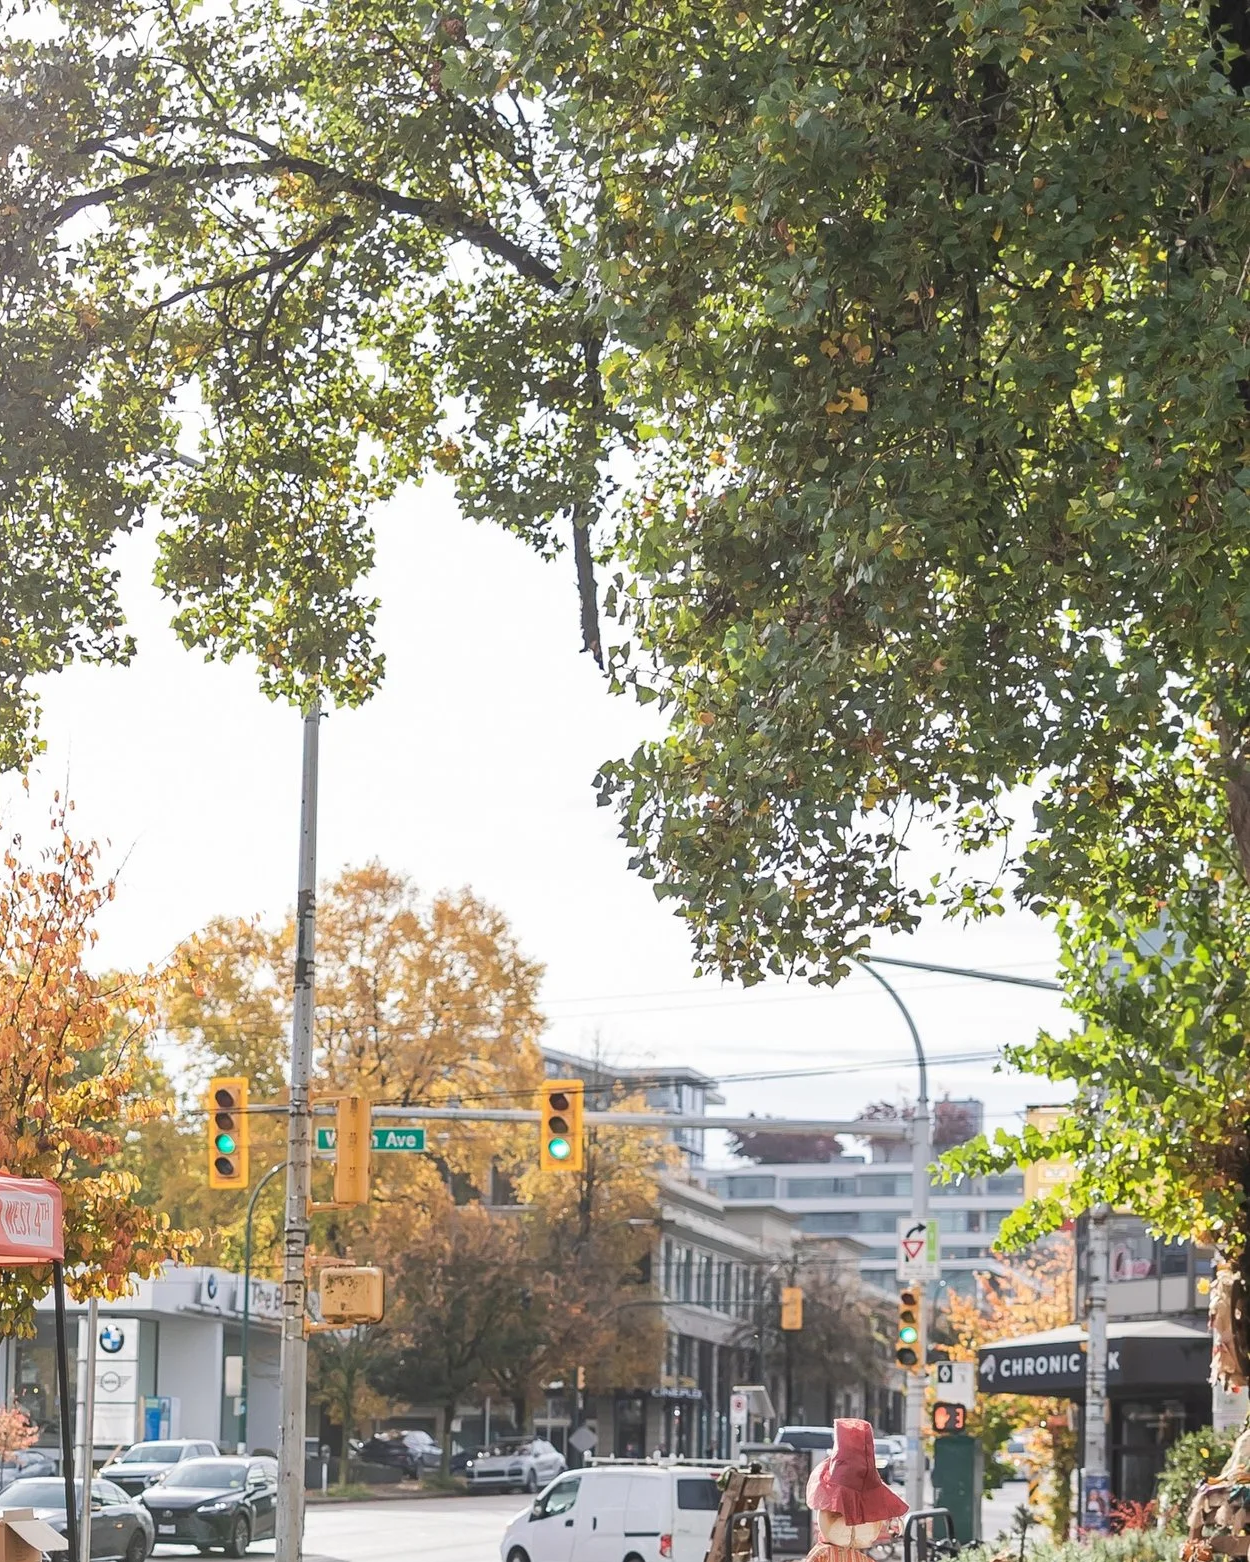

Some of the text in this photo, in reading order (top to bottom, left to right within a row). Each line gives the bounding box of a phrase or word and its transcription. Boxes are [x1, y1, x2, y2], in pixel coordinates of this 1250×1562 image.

[385, 1131, 417, 1148] Ave
[5, 1200, 50, 1237] WEST 4TH
[1000, 1353, 1081, 1377] CHRONIC
[954, 1407, 964, 1430] 3
